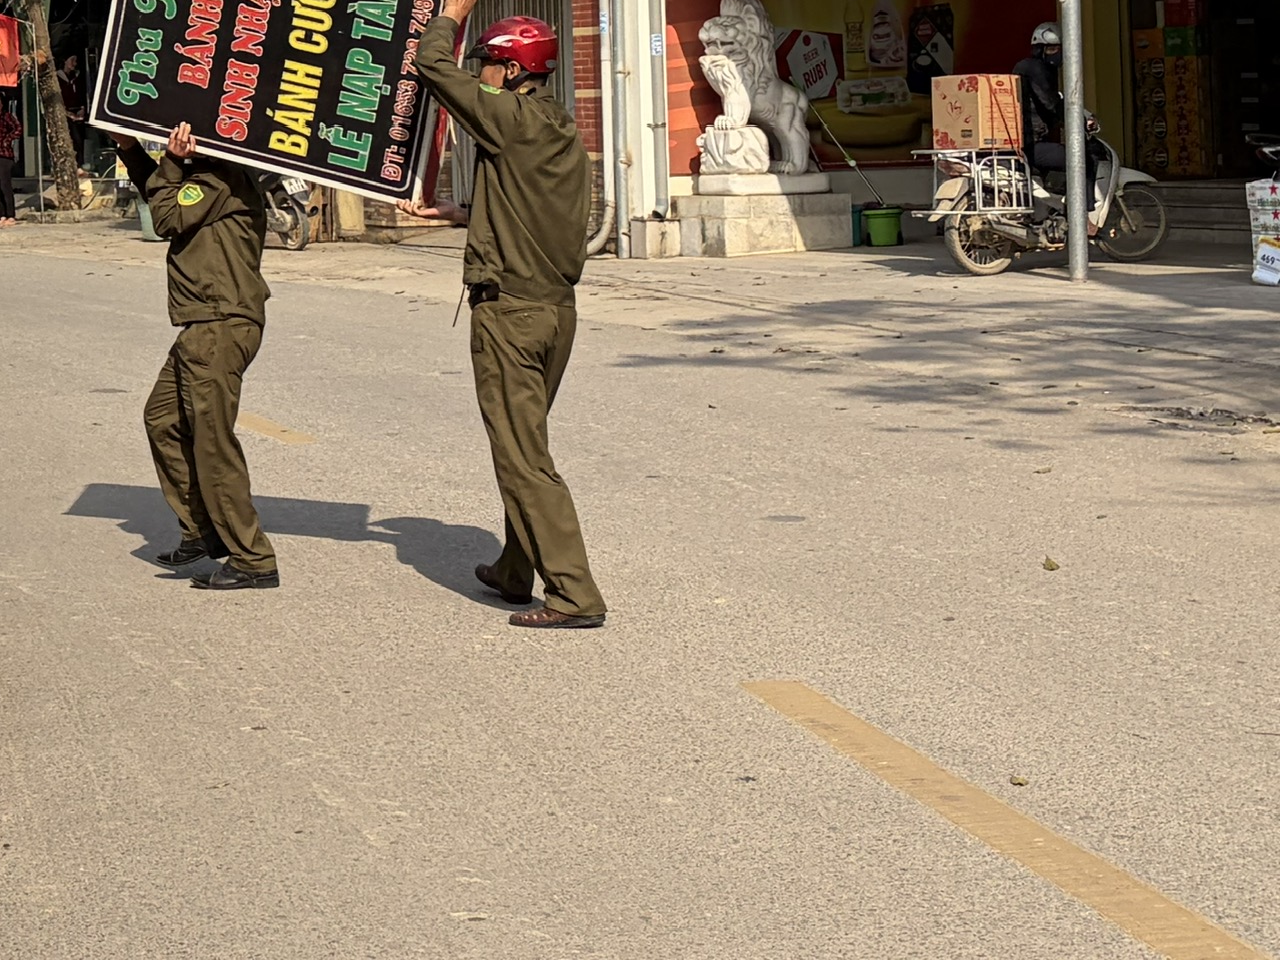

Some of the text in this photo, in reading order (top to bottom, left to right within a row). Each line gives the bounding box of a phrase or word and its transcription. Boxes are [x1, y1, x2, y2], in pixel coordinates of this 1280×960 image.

[117, 27, 163, 106] Thu
[336, 47, 391, 123] NẠP
[802, 48, 819, 64] BEER
[802, 60, 829, 90] RUBY
[215, 58, 260, 142] SINH
[265, 59, 323, 158] BÁNH
[318, 121, 373, 172] LỄ
[380, 144, 407, 182] ĐT:
